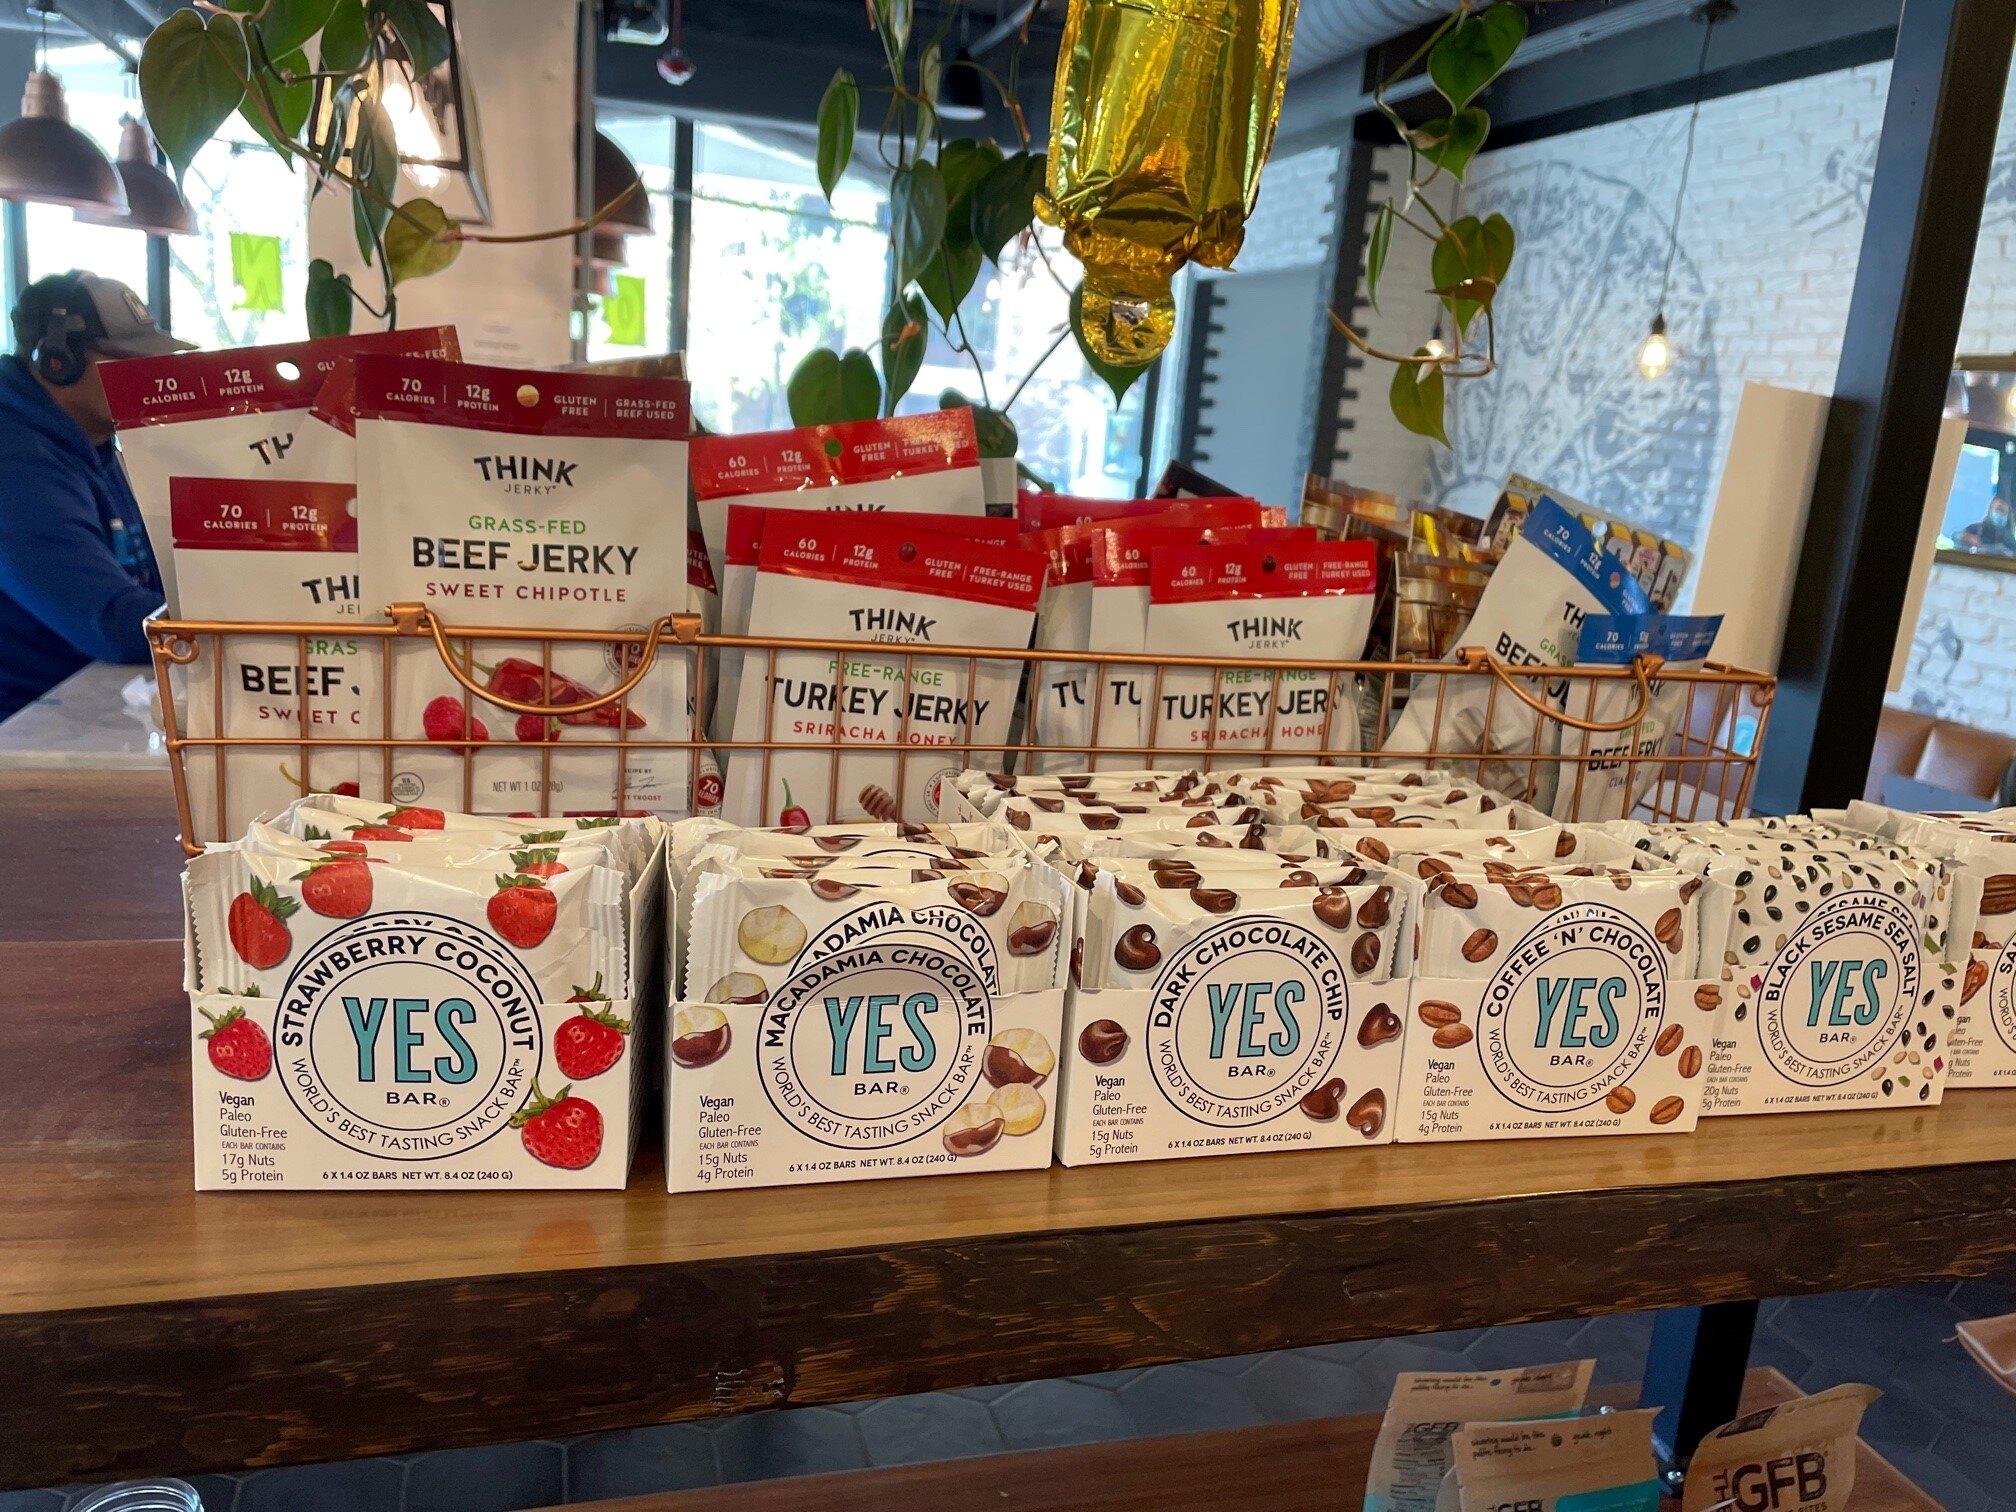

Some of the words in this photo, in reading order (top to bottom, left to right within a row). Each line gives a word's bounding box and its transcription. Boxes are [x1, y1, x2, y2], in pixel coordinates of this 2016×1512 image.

[224, 369, 252, 384] 12g
[155, 378, 178, 392] 70
[219, 384, 264, 397] PROTEIN
[402, 378, 422, 392] 70
[143, 391, 196, 405] CALORIES
[386, 392, 435, 405] CALORIES
[466, 384, 490, 402] 12g
[457, 400, 499, 412] PROTEIN
[554, 395, 597, 406] GLUTEN
[616, 398, 676, 410] GRASS-FED
[562, 406, 589, 416] FREE
[616, 409, 643, 419] BEEF
[646, 410, 675, 420] USED
[853, 441, 891, 454] GLUTEN
[903, 443, 938, 456] TURKEY
[728, 456, 746, 468] 60
[781, 450, 802, 463] 12g
[862, 452, 886, 462] FREE
[474, 456, 579, 487] THINK
[717, 468, 760, 480] CALORIES
[777, 463, 811, 473] PROTEIN
[220, 504, 243, 518] 70
[291, 506, 318, 522] 12g
[204, 520, 258, 530] CALORIES
[282, 522, 327, 532] PROTEIN
[469, 515, 587, 535] GRASS-FED
[1557, 525, 1570, 540] 70
[798, 538, 816, 550] 60
[412, 536, 511, 571] BEEF
[517, 543, 640, 576] JERKY
[783, 549, 825, 562] CALORIES
[853, 545, 874, 560] 12g
[1125, 550, 1140, 560] 60
[843, 558, 879, 569] PROTEIN
[925, 558, 961, 570] GLUTEN
[1225, 563, 1242, 576] 12g
[1284, 562, 1313, 572] GLUTEN
[1323, 561, 1369, 570] FREE-RANGE
[929, 568, 953, 579] FREE
[973, 566, 1032, 583] FREE-RANGE
[1181, 566, 1196, 577] 60
[1288, 571, 1308, 580] FREE
[1321, 570, 1345, 578] TURKEY
[1348, 569, 1371, 578] USED
[968, 575, 1004, 587] TURKEY
[1008, 581, 1032, 592] USED
[1171, 578, 1204, 587] CALORIES
[1217, 575, 1246, 585] PROTEIN
[426, 582, 504, 599] SWEET
[516, 585, 626, 602] CHIPOTLE
[849, 608, 938, 642] THINK
[1227, 617, 1303, 642] THINK
[1607, 631, 1619, 642] 70
[764, 676, 889, 715] TURKEY
[894, 694, 990, 726] JERKY
[1162, 691, 1269, 720] TURKEY
[493, 782, 509, 792] NET
[510, 781, 523, 792] WT
[703, 779, 719, 795] 70
[1766, 936, 1811, 1001] BLACK
[1812, 913, 1885, 941] SESAME
[1884, 921, 1910, 953] SEA
[1902, 953, 1916, 997] SALT
[1154, 964, 1197, 1028] DARK
[1196, 927, 1329, 969] CHOCOLATE
[1322, 969, 1342, 1021] CHIP
[1487, 940, 1550, 1018] COFFEE
[1589, 926, 1661, 1019] CHOCOLATE
[281, 935, 427, 1047] STRAWBERRY
[435, 941, 534, 1051] COCONUT
[765, 950, 884, 1047] MACADAMIA
[891, 949, 985, 1037] CHOCOLATE
[1807, 959, 1888, 1027] YES
[1534, 976, 1627, 1048] YES
[1207, 980, 1305, 1059] YES
[823, 991, 939, 1076] YES
[341, 996, 478, 1085] YES
[1712, 1038, 1737, 1050] Vegan
[1710, 1051, 1731, 1061] Paleo
[1428, 1059, 1455, 1072] Vegan
[1708, 1064, 1752, 1074] Gluten-Free
[1095, 1075, 1125, 1088] Vegan
[1426, 1073, 1450, 1083] Paleo
[772, 1056, 811, 1118] WORLD'S
[808, 1113, 841, 1135] BEST
[844, 1119, 909, 1140] TASTING
[910, 1083, 959, 1126] SNACK
[1094, 1090, 1121, 1101] Paleo
[1424, 1087, 1473, 1098] Gluten-Free
[1704, 1086, 1720, 1097] 20g
[1721, 1086, 1739, 1095] Nuts
[219, 1091, 255, 1108] Vegan
[291, 1057, 341, 1124] WORLD'S
[338, 1119, 377, 1144] BEST
[382, 1133, 454, 1151] TASTING
[455, 1097, 509, 1140] SNACK
[700, 1096, 734, 1110] Vegan
[1702, 1098, 1712, 1109] 5g
[1714, 1098, 1741, 1107] Protein
[220, 1108, 252, 1122] Paleo
[1093, 1104, 1147, 1116] Gluten-Free
[1421, 1110, 1437, 1121] 15g
[1439, 1109, 1459, 1120] Nuts
[700, 1111, 730, 1123] Paleo
[220, 1124, 288, 1139] Gluten-Free
[699, 1125, 762, 1139] Gluten-Free
[1418, 1124, 1429, 1135] 4g
[1432, 1123, 1462, 1134] Protein
[1092, 1130, 1110, 1143] 15g
[1112, 1130, 1134, 1140] Nuts
[222, 1141, 238, 1149] EACH
[240, 1141, 253, 1150] BAR
[255, 1142, 286, 1150] CONTAINS
[1090, 1145, 1102, 1158] 5g
[1104, 1143, 1138, 1155] Protein
[223, 1154, 245, 1168] 17g
[249, 1154, 275, 1166] Nuts
[699, 1154, 720, 1167] 15g
[723, 1153, 748, 1164] Nuts
[222, 1170, 237, 1184] 5g
[241, 1170, 284, 1182] Protein
[323, 1171, 328, 1180] 6
[331, 1171, 338, 1180] X
[340, 1171, 353, 1180] 1.4
[355, 1171, 370, 1180] OZ
[372, 1171, 398, 1180] BARS
[402, 1171, 421, 1180] NET
[424, 1171, 442, 1180] WT.
[444, 1171, 460, 1180] 8.4
[461, 1171, 475, 1180] OZ
[477, 1171, 499, 1181] (240
[500, 1171, 513, 1181] G)
[697, 1169, 711, 1183] 4g
[715, 1167, 754, 1179] Protein
[1732, 1452, 1827, 1512] GFB
